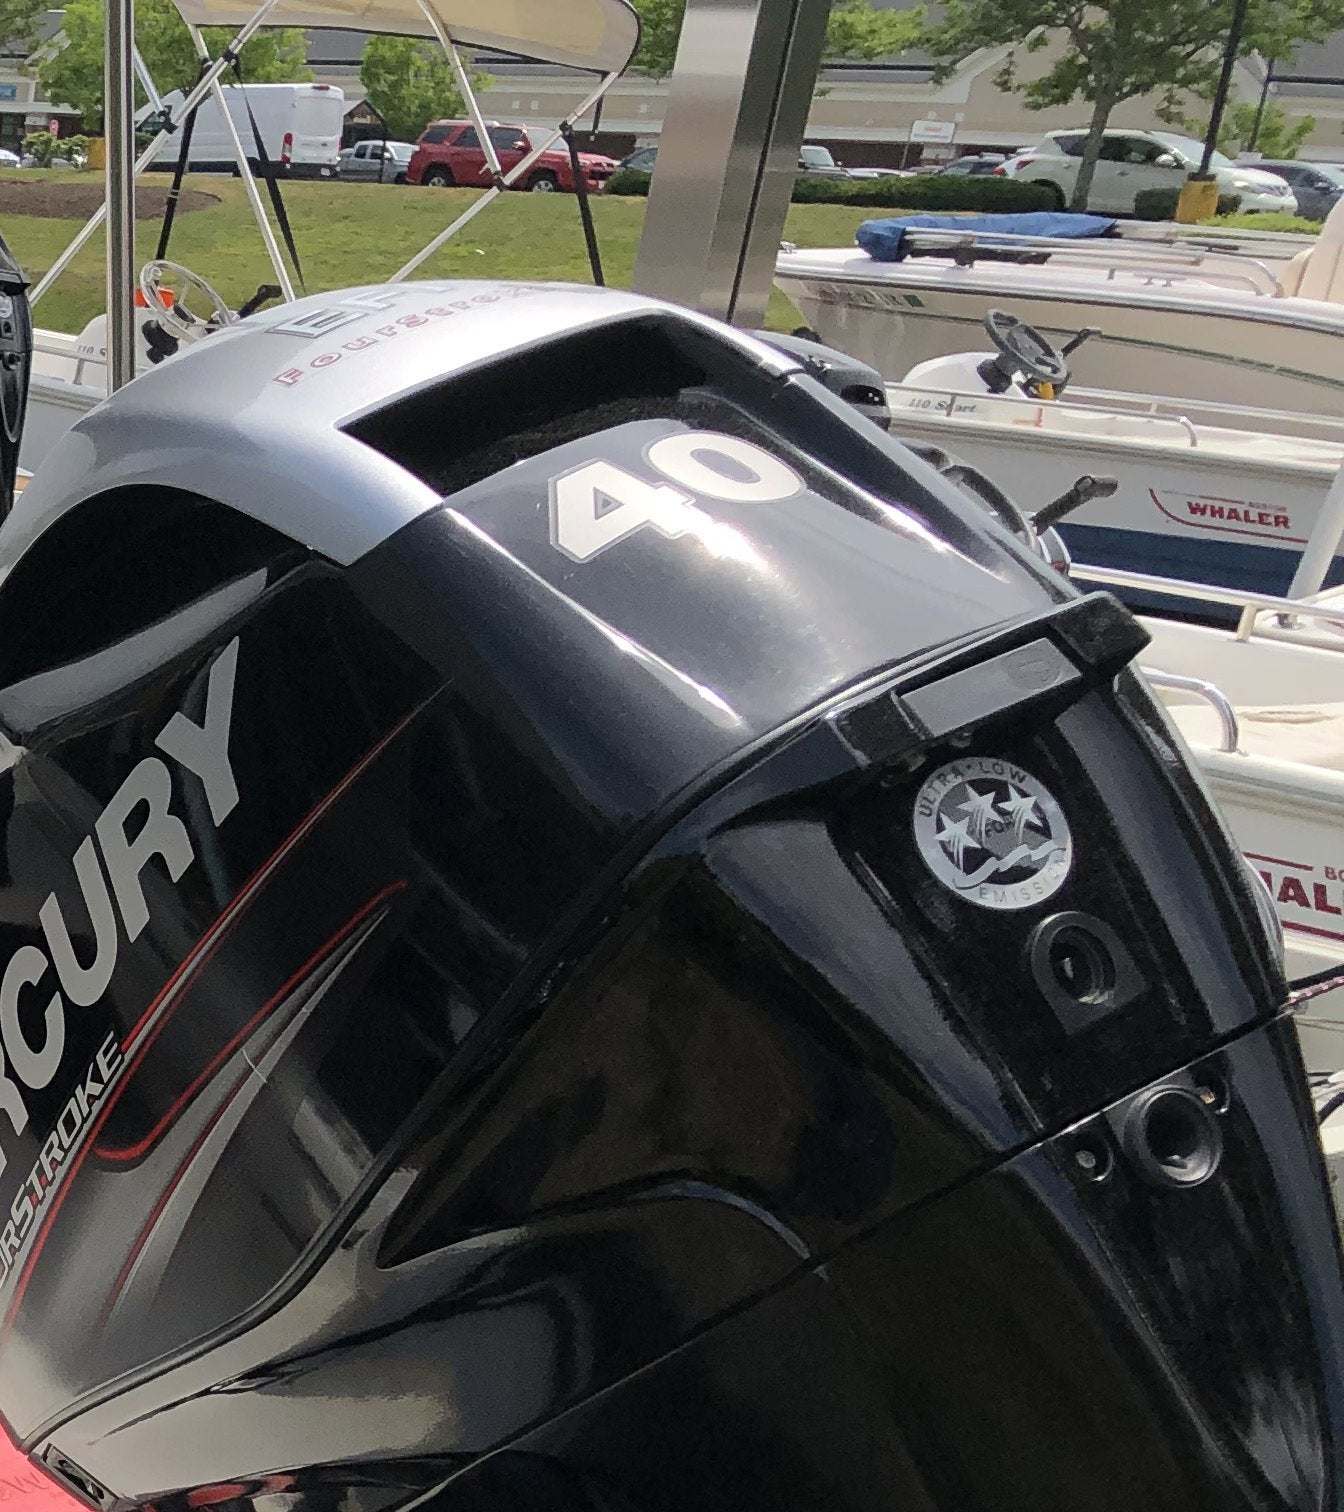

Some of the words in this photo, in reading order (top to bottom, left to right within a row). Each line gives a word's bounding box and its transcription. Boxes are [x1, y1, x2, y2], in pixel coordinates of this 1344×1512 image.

[548, 428, 808, 563] 40
[1187, 501, 1291, 529] WHALER
[918, 764, 963, 818] ULTRA
[978, 760, 1027, 785] LOW
